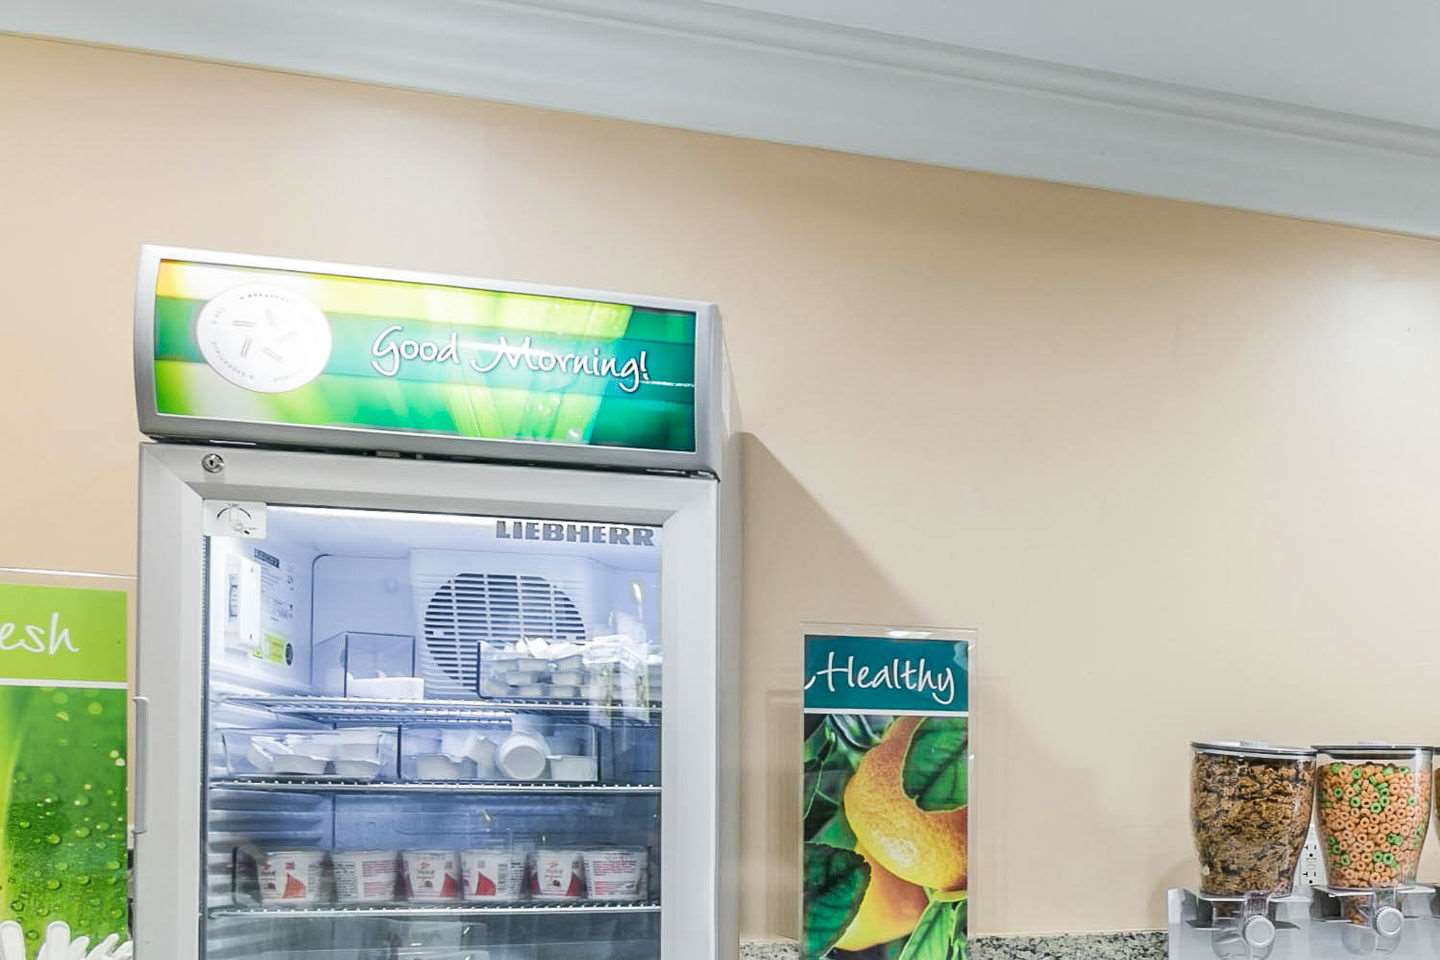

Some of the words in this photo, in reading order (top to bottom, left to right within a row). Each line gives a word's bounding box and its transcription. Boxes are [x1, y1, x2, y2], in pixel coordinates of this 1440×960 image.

[371, 325, 460, 377] Good
[469, 336, 649, 393] Morning!
[496, 520, 654, 546] LIEBHERR
[804, 650, 955, 705] Healthy
